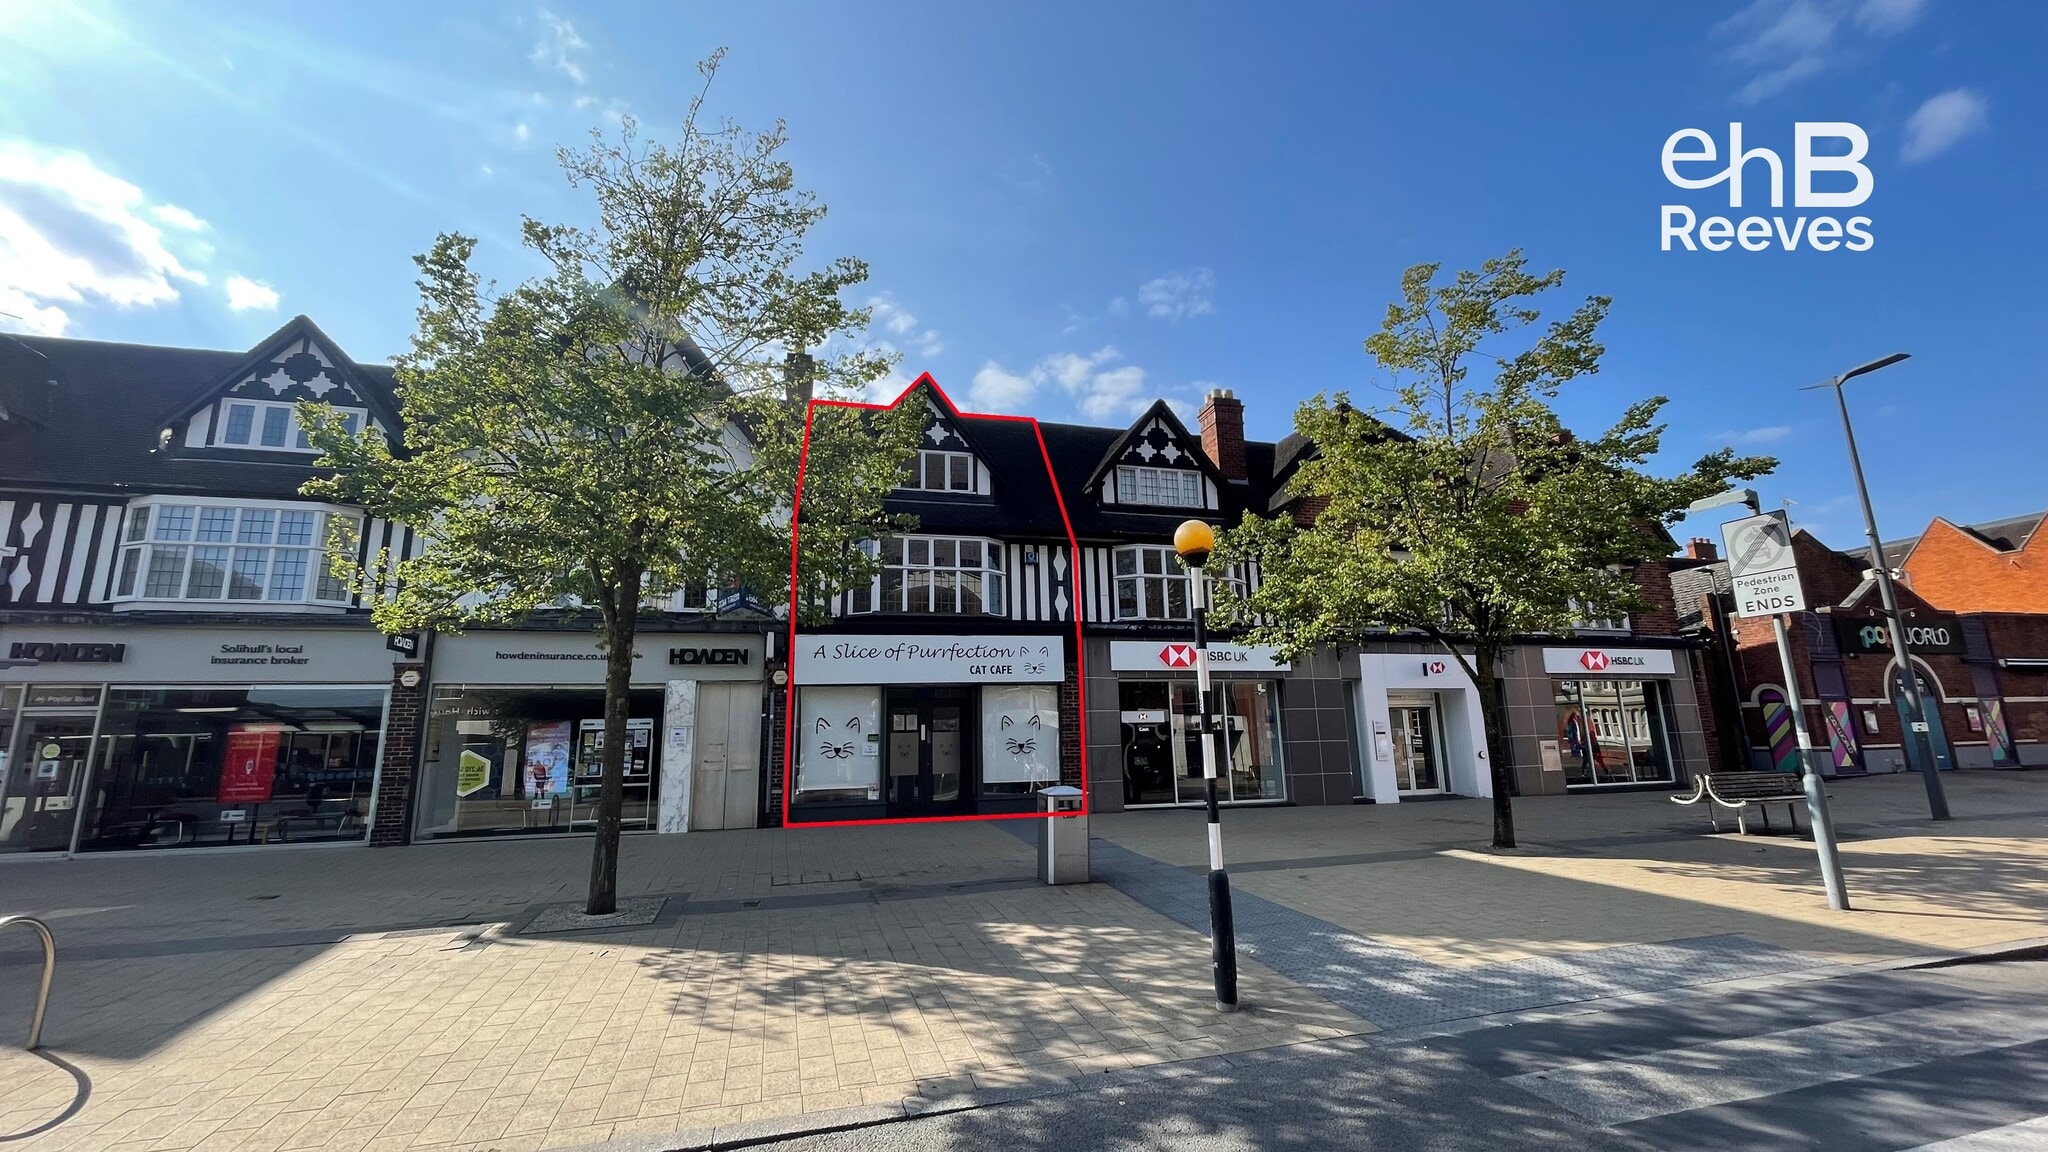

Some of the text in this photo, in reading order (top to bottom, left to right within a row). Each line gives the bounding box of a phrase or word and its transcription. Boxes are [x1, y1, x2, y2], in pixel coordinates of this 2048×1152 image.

[1737, 573, 1794, 588] Pedestrian
[1754, 586, 1780, 595] Zone
[1745, 596, 1795, 612] ENDS
[9, 643, 126, 663] HOWDEN
[221, 644, 303, 654] Solihull's local
[813, 643, 1016, 661] A Slice of Purrfection
[211, 656, 309, 665] insurance broker
[669, 649, 749, 665] HOWDEN
[1234, 652, 1248, 661] UK
[1611, 657, 1633, 665] HSBC
[969, 665, 1013, 675] CAT CAFE
